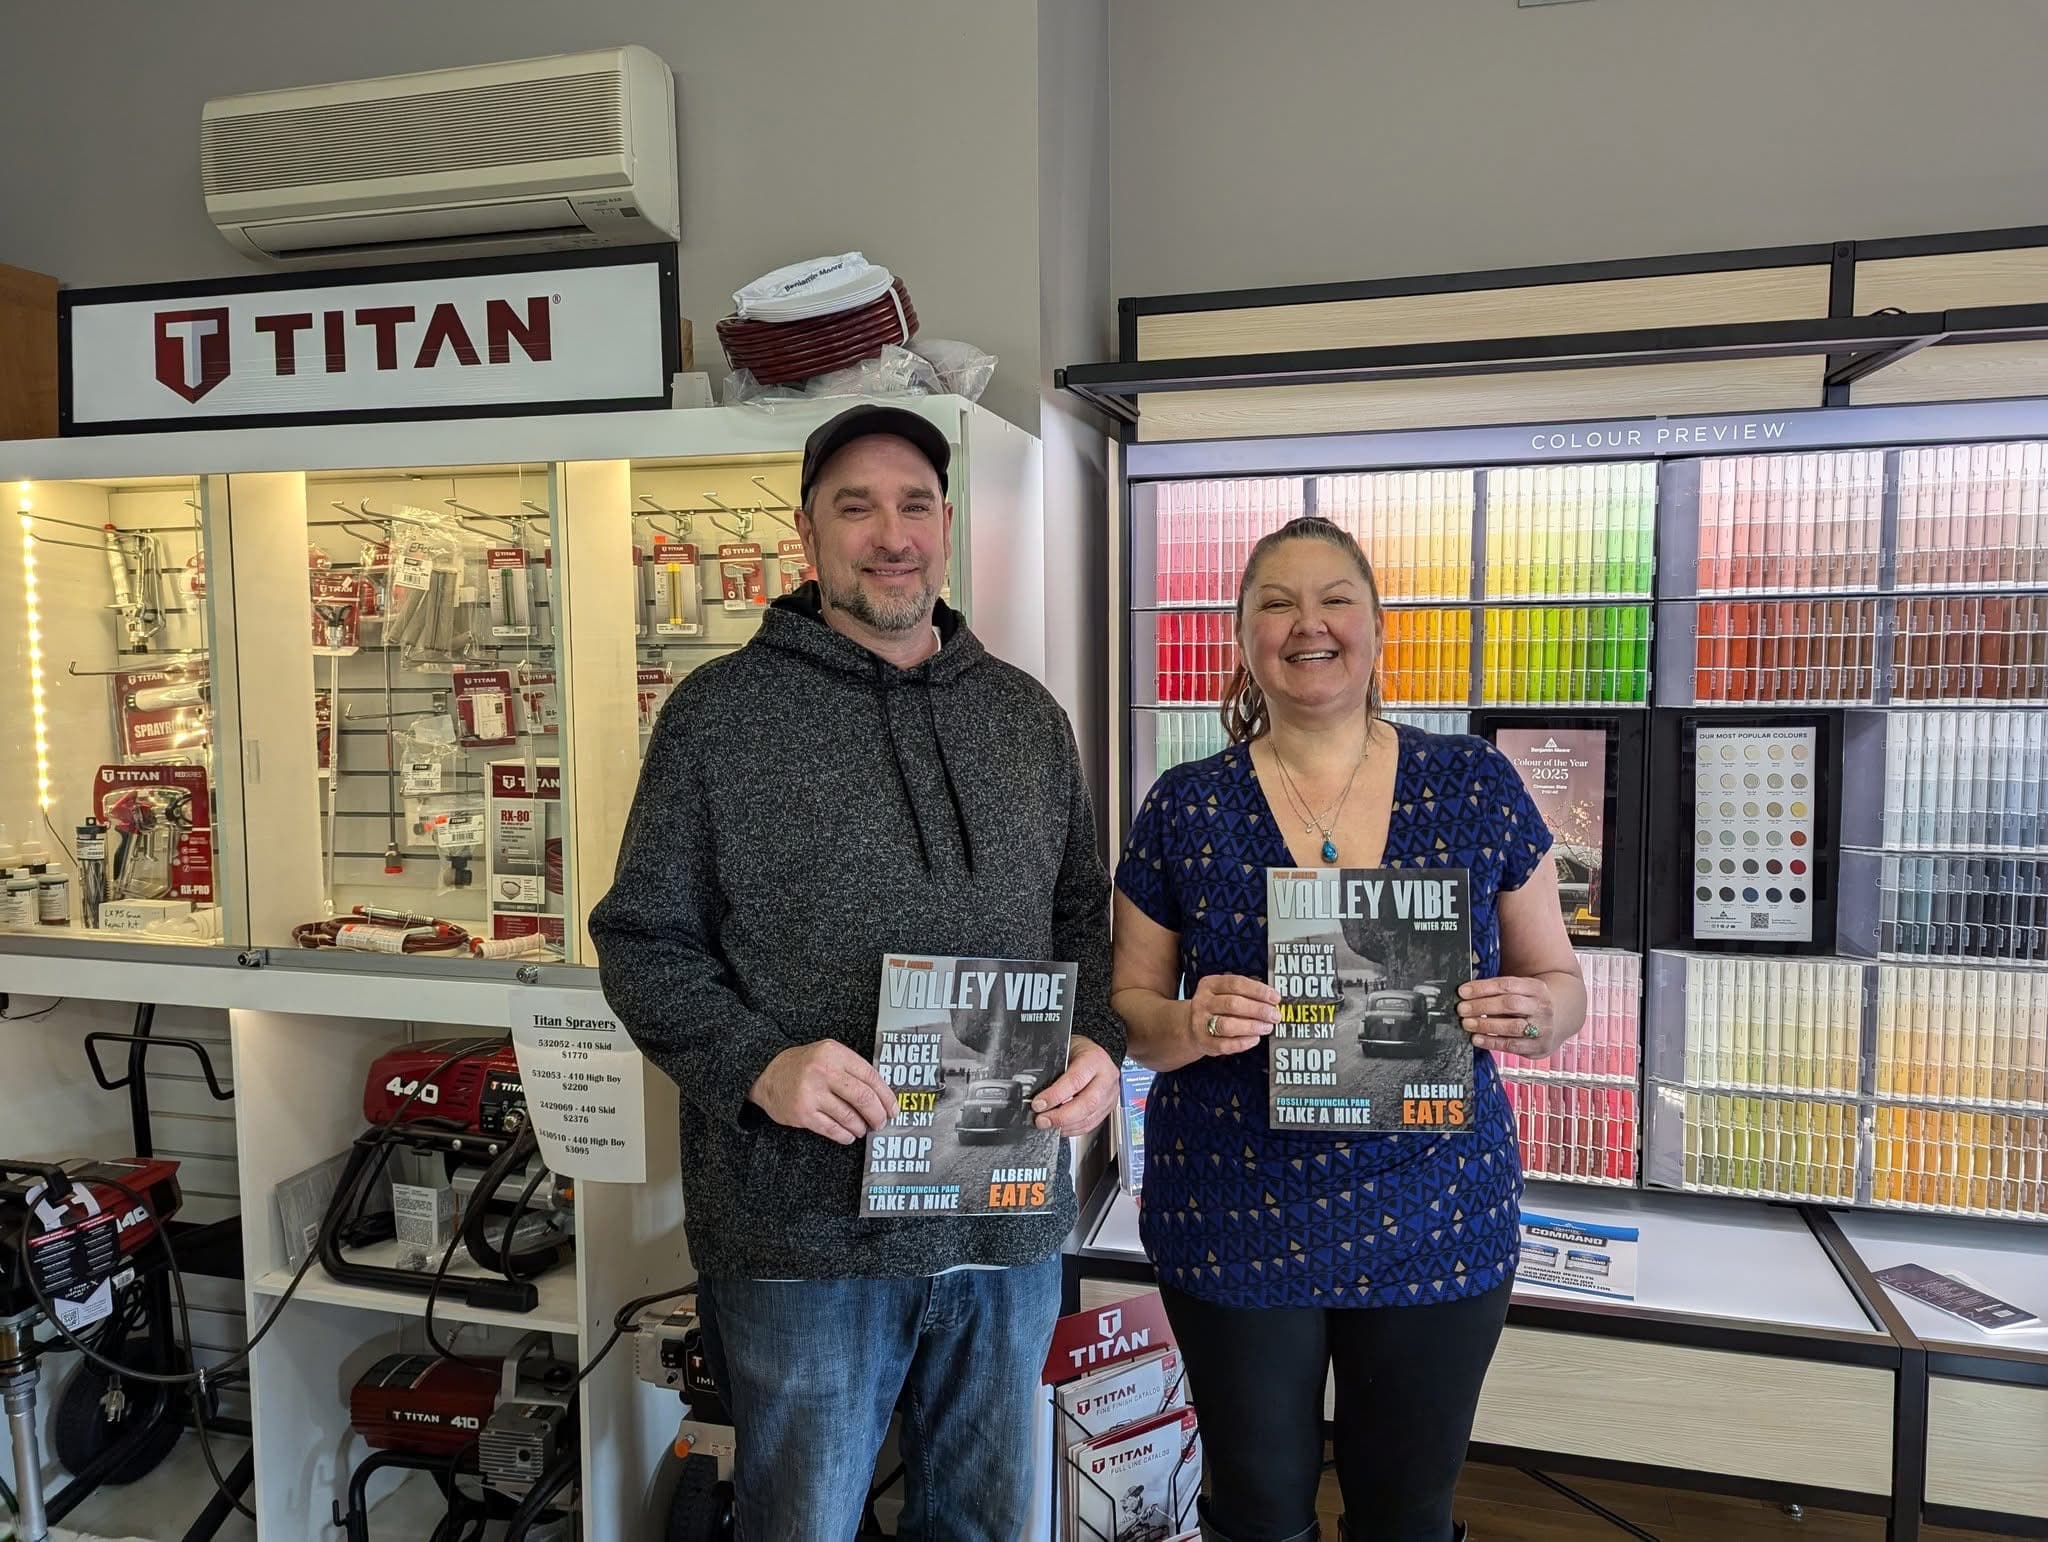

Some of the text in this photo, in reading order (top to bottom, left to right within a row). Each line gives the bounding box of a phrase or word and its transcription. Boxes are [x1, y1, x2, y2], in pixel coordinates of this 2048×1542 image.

[784, 263, 843, 291] Benjamin Moore
[255, 296, 552, 376] TITAN
[1531, 423, 1785, 449] COLOUR PREVIEW
[137, 673, 163, 682] TITAN
[1513, 758, 1588, 767] Colour of the Year
[117, 771, 160, 780] TITAN
[1532, 768, 1568, 780] 2025
[518, 777, 560, 788] TTAN
[501, 810, 530, 822] RX-80
[181, 885, 210, 895] RX-PRO
[1273, 880, 1459, 919] VALLEY VIBE
[1414, 921, 1457, 931] WINTER 2025
[1274, 943, 1335, 954] THE STORY OF
[1274, 954, 1335, 974] ANGEL
[889, 968, 1067, 1011] VALLEY VIBE
[1274, 975, 1335, 998] ROCK
[1020, 1013, 1061, 1022] WINTER 2025
[1276, 1004, 1335, 1023] MAJESTY
[533, 1015, 617, 1030] Titan Sprayers
[882, 1032, 942, 1043] THE STORY OF
[1275, 1024, 1336, 1039] IN THE SKY
[538, 1039, 570, 1048] 532052
[577, 1042, 592, 1050] 410
[594, 1042, 612, 1050] Skid
[562, 1051, 588, 1060] $1770
[880, 1043, 940, 1063] ANGEL
[1275, 1048, 1336, 1071] SHOP
[532, 1069, 561, 1079] 532053
[568, 1072, 584, 1080] 410
[586, 1073, 604, 1083] High
[606, 1075, 621, 1084] Boy
[879, 1064, 938, 1086] ROCK
[1275, 1072, 1336, 1085] ALBERNI
[386, 1076, 439, 1105] 440
[500, 1082, 524, 1093] TITA
[562, 1082, 588, 1091] $2200
[1403, 1084, 1464, 1098] ALBERNI
[540, 1100, 573, 1112] 2429069
[580, 1105, 596, 1113] 440
[598, 1106, 616, 1114] Skid
[1304, 1098, 1349, 1107] PROVINCIAL
[1350, 1099, 1370, 1107] PARK
[563, 1114, 589, 1123] $2376
[913, 1112, 935, 1126] SKY
[1276, 1106, 1370, 1124] TAKE A HIKE
[1402, 1100, 1465, 1125] EATS
[573, 1136, 588, 1145] 440
[590, 1137, 608, 1147] High
[610, 1138, 625, 1148] Boy
[872, 1136, 932, 1160] SHOP
[565, 1145, 590, 1155] $3095
[870, 1160, 930, 1173] ALBERNI
[992, 1167, 1048, 1182] ALBERNI
[896, 1185, 939, 1194] PROVINCIAL
[941, 1184, 960, 1193] PARK
[988, 1183, 1045, 1207] EATS
[868, 1194, 960, 1210] TAKE A HIKE
[1531, 1227, 1603, 1245] COMMAND
[1069, 1328, 1150, 1368] TITAN
[1094, 1384, 1136, 1407] TITAN
[1096, 1386, 1160, 1416] FINE FINISH CATALOG
[404, 1411, 440, 1423] TITAN
[450, 1415, 480, 1430] 410
[1109, 1444, 1153, 1466] TITAN
[1110, 1449, 1170, 1475] FULL LINE CATALOG
